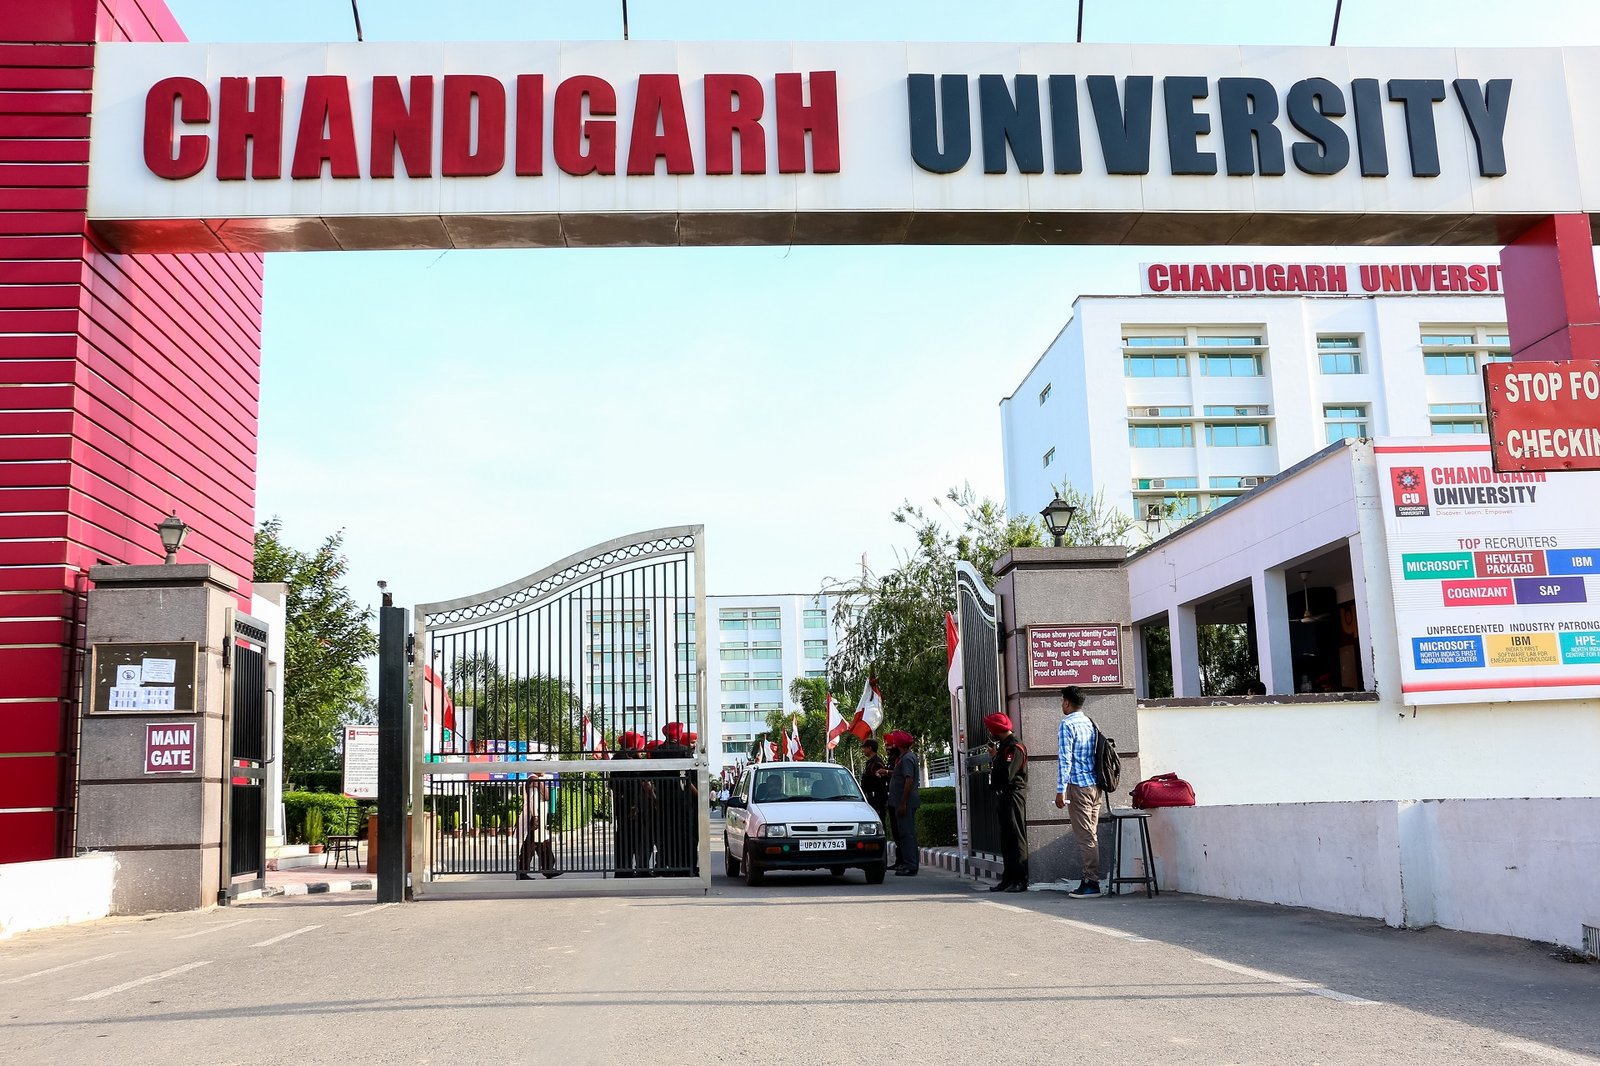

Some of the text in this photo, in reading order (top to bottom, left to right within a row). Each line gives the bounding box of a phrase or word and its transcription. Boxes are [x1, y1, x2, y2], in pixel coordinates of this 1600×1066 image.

[143, 71, 1513, 181] CHANDIGARH UNIVERSITY
[1148, 264, 1501, 292] CHANDIGARH UNIVERSI
[1504, 371, 1600, 403] STOP FO
[1402, 492, 1420, 504] CU
[1433, 486, 1536, 506] UNIVERSITY
[1458, 536, 1558, 550] TOP RECRUITERS
[1485, 554, 1533, 564] HEWLETT
[1572, 556, 1592, 567] IBM
[1406, 560, 1469, 572] MICROSOFT
[1486, 563, 1534, 574] PACKARD
[1447, 586, 1508, 598] COGNIZANT
[1540, 586, 1561, 596] SAP
[1068, 631, 1080, 639] your
[1082, 630, 1102, 638] Identity
[1426, 624, 1504, 635] UNPRECEDENTED
[1510, 622, 1555, 632] INDUSTRY
[1053, 640, 1076, 648] Security
[1420, 640, 1475, 651] MICROSOFT
[1511, 636, 1531, 646] IBM
[1092, 675, 1100, 683] By
[151, 730, 190, 746] MAIN
[150, 750, 190, 766] GATE
